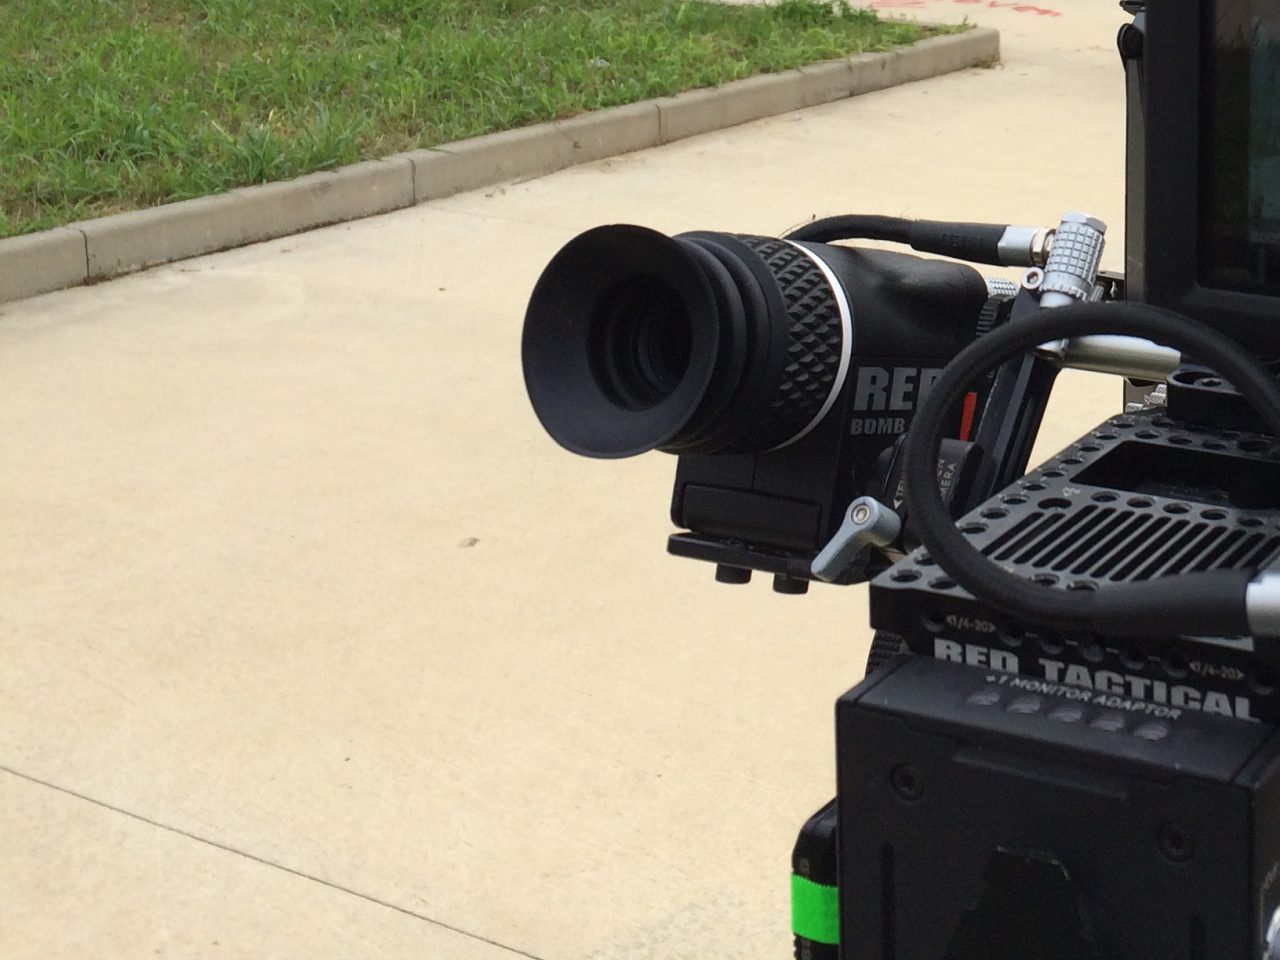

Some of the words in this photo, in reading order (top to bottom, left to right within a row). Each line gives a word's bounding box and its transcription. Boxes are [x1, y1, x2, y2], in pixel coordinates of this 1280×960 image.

[850, 418, 905, 436] BOMB
[934, 637, 1019, 675] RED
[1038, 657, 1263, 724] TACTICAL
[1010, 677, 1092, 702] MONITOR
[1092, 694, 1182, 720] ADAPTOR
